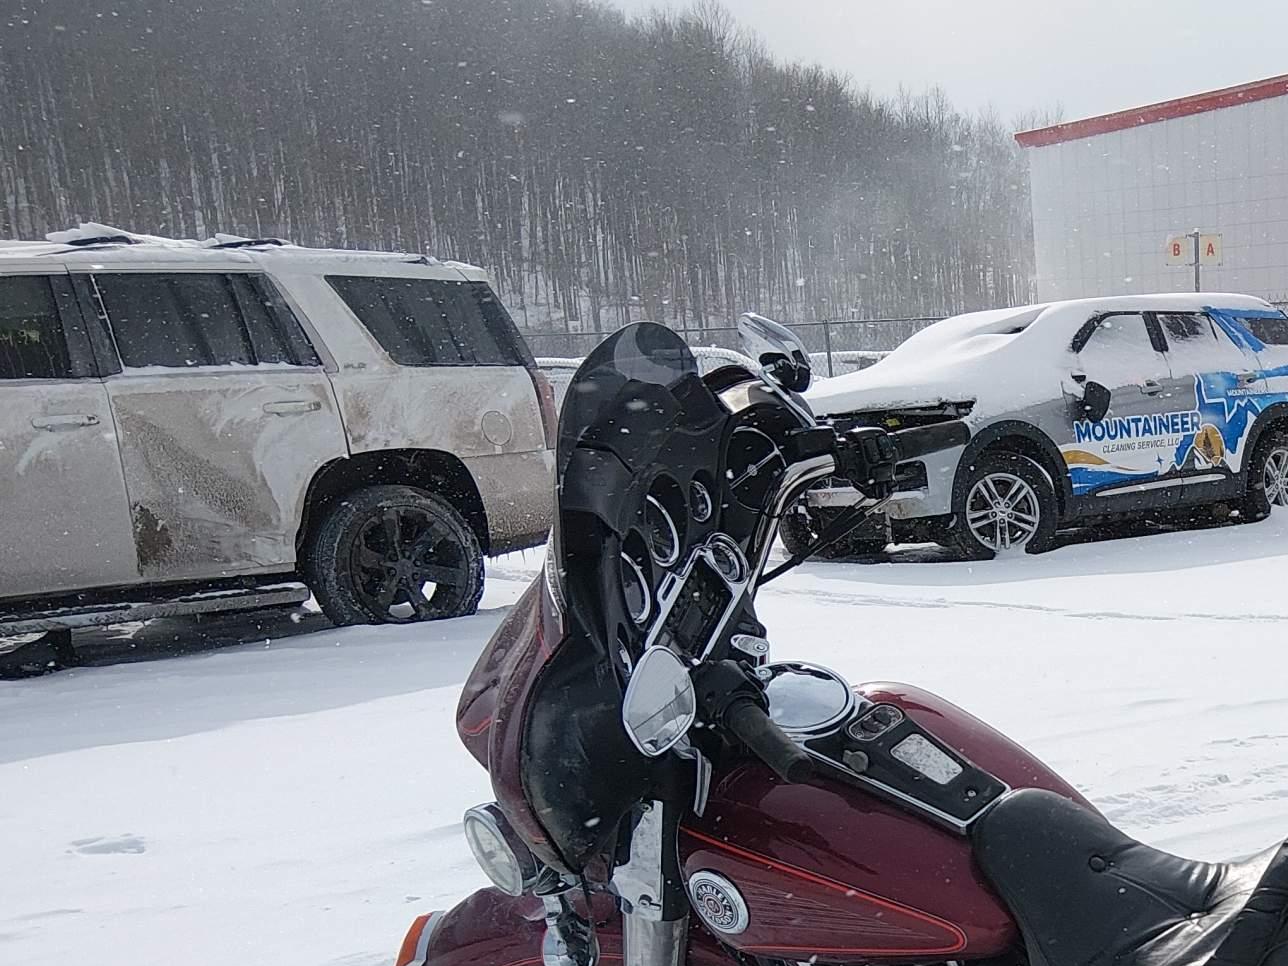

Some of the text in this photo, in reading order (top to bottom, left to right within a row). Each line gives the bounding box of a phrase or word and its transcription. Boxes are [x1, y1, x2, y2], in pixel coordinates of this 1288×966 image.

[1172, 242, 1181, 257] B
[1206, 242, 1215, 257] A
[1074, 412, 1200, 443] MOUNTAINEER
[1102, 438, 1180, 454] CLEANING SERVICE, LLC
